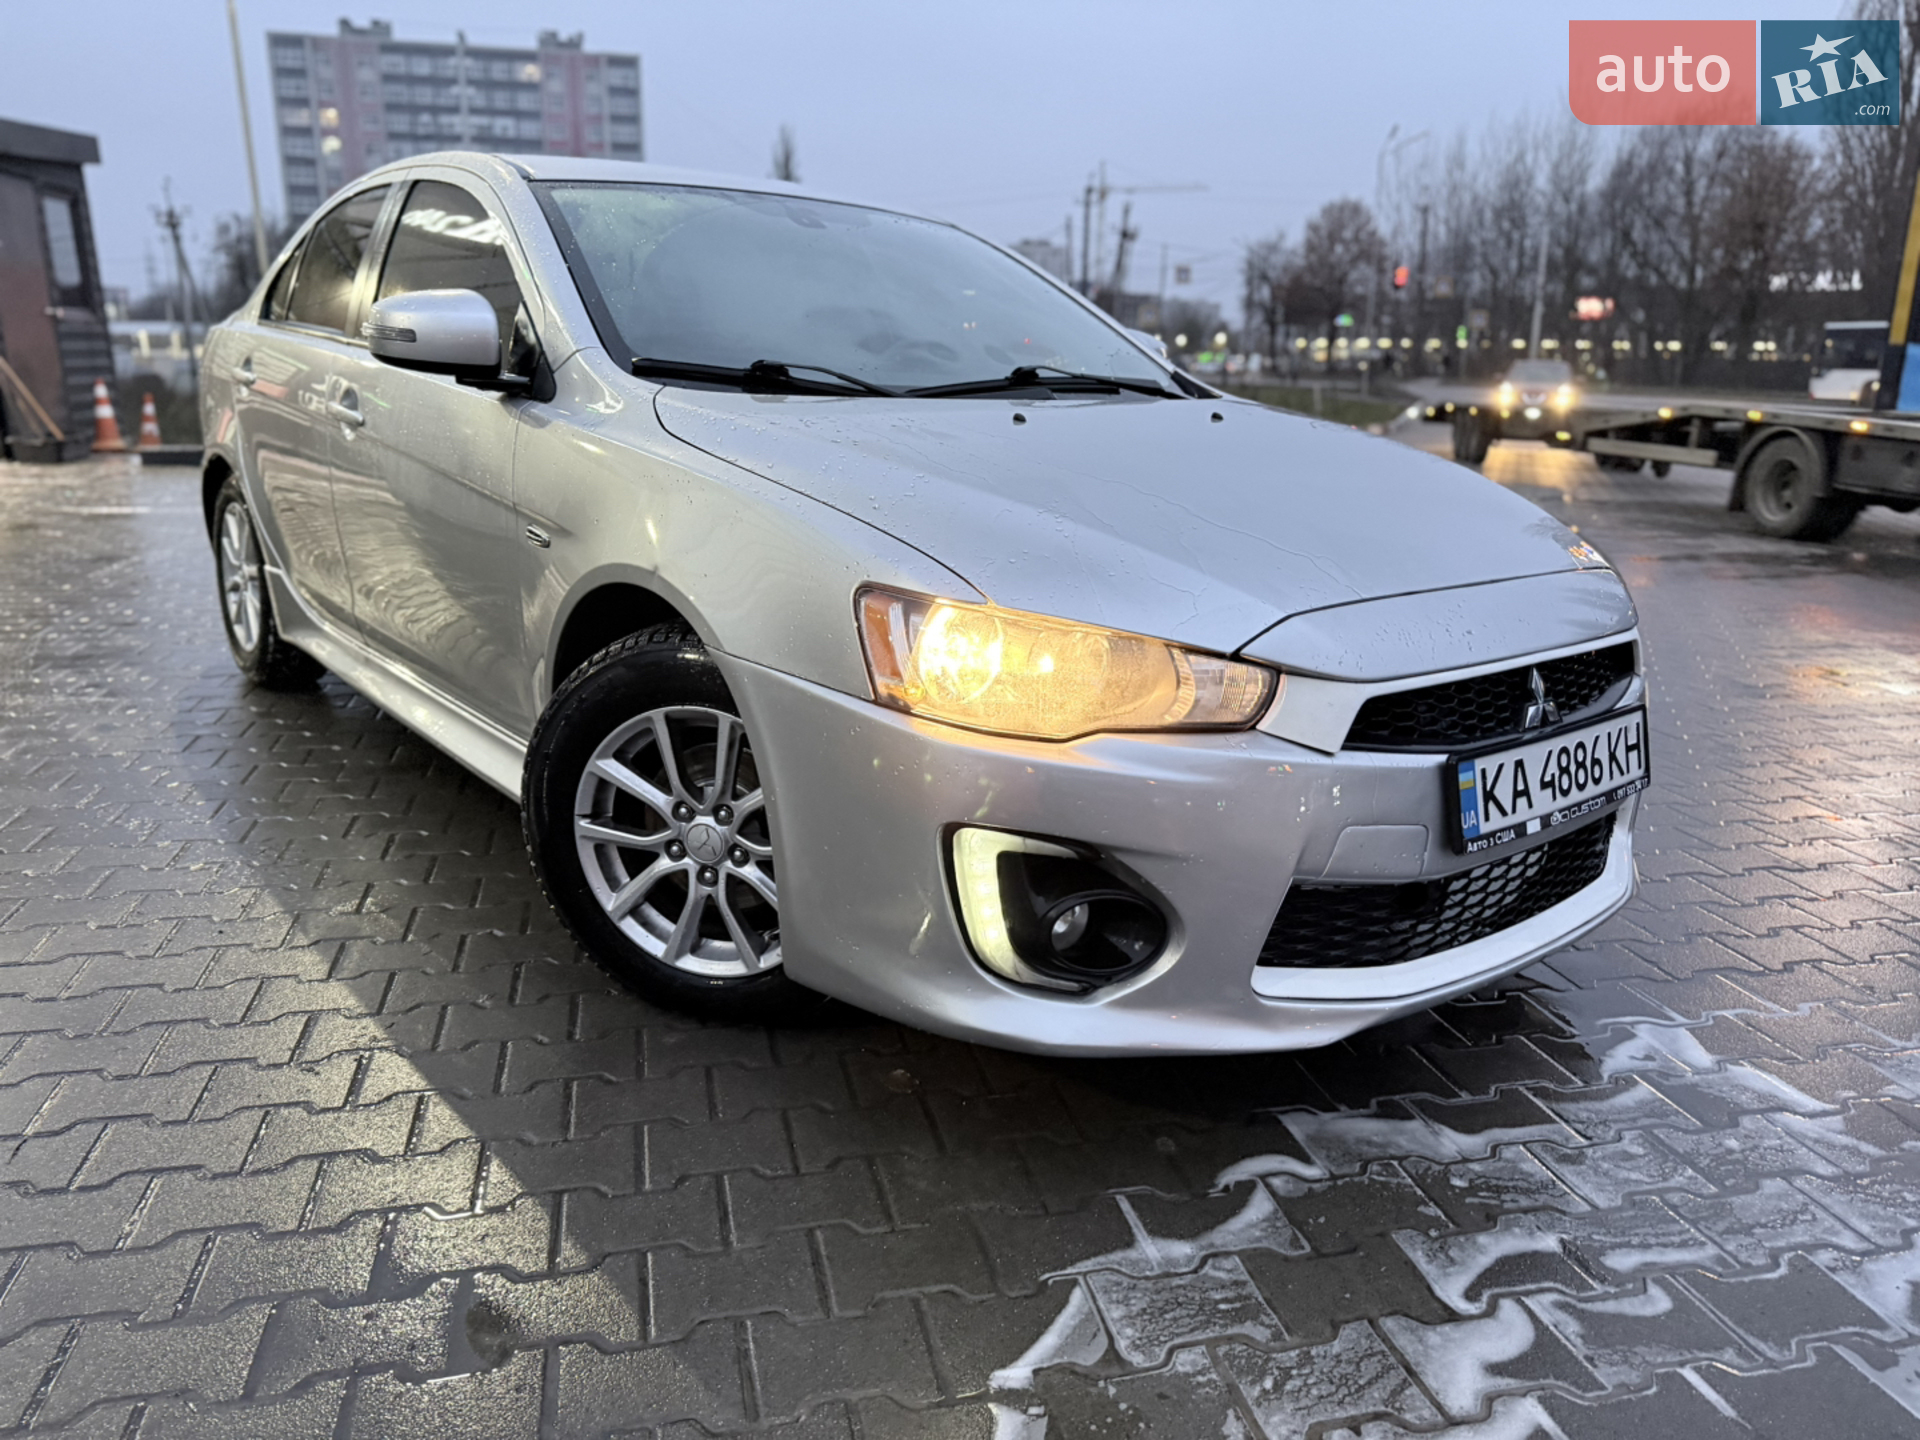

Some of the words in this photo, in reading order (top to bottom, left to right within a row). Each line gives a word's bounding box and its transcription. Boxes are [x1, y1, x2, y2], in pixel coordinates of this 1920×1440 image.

[1480, 757, 1533, 823] KA
[1539, 734, 1603, 802] 4886
[1607, 721, 1642, 781] KH
[1461, 810, 1478, 829] UA
[1495, 828, 1516, 845] США
